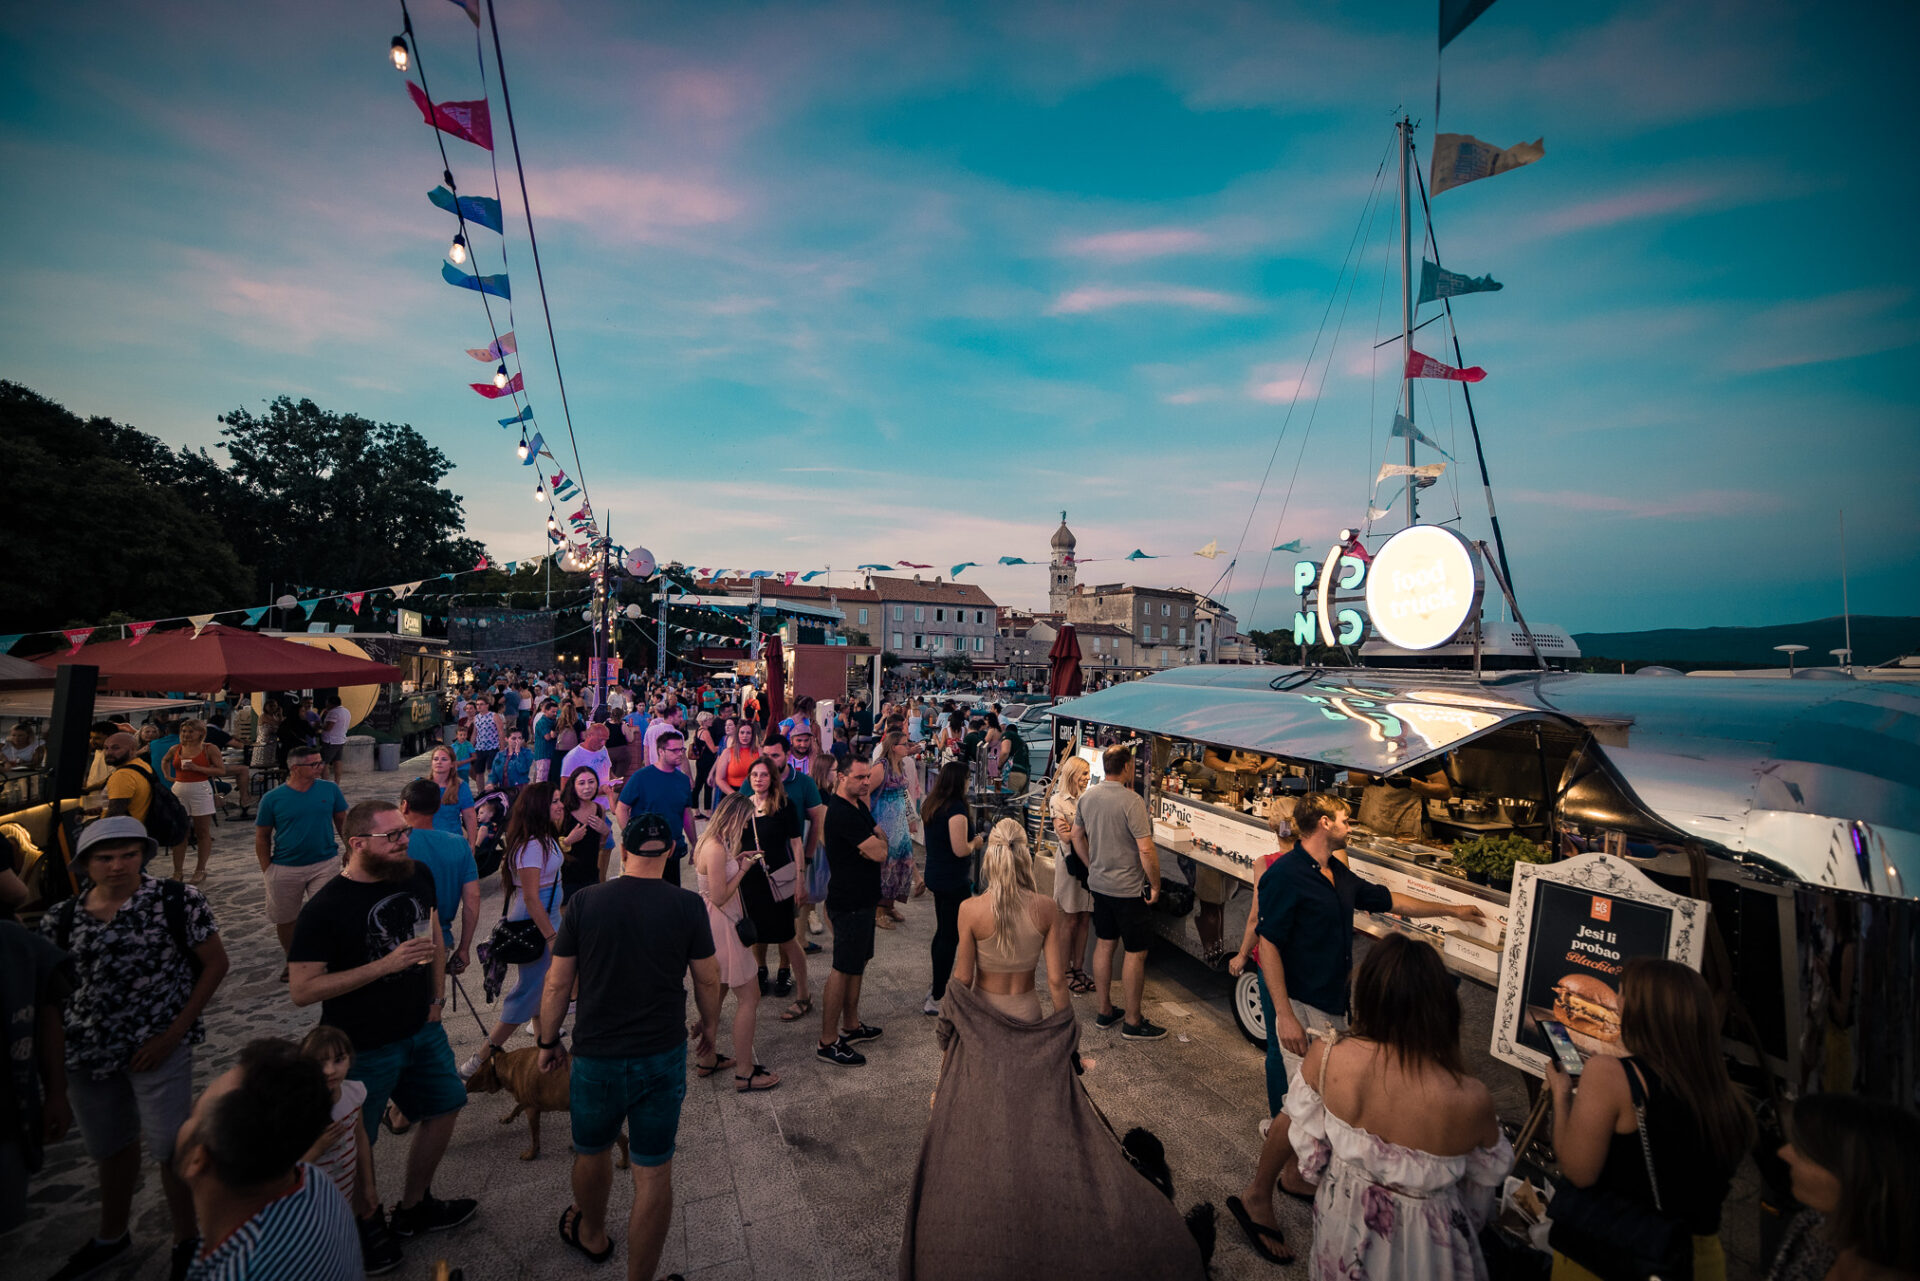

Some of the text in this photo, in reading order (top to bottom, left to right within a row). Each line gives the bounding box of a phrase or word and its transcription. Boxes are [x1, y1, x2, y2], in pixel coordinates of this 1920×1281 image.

[1392, 558, 1445, 592] food
[1390, 585, 1457, 618] truck
[1576, 925, 1617, 944] Jesi li
[1456, 944, 1480, 958] Tissue
[1571, 938, 1621, 960] probao
[1565, 951, 1624, 975] Blackie?
